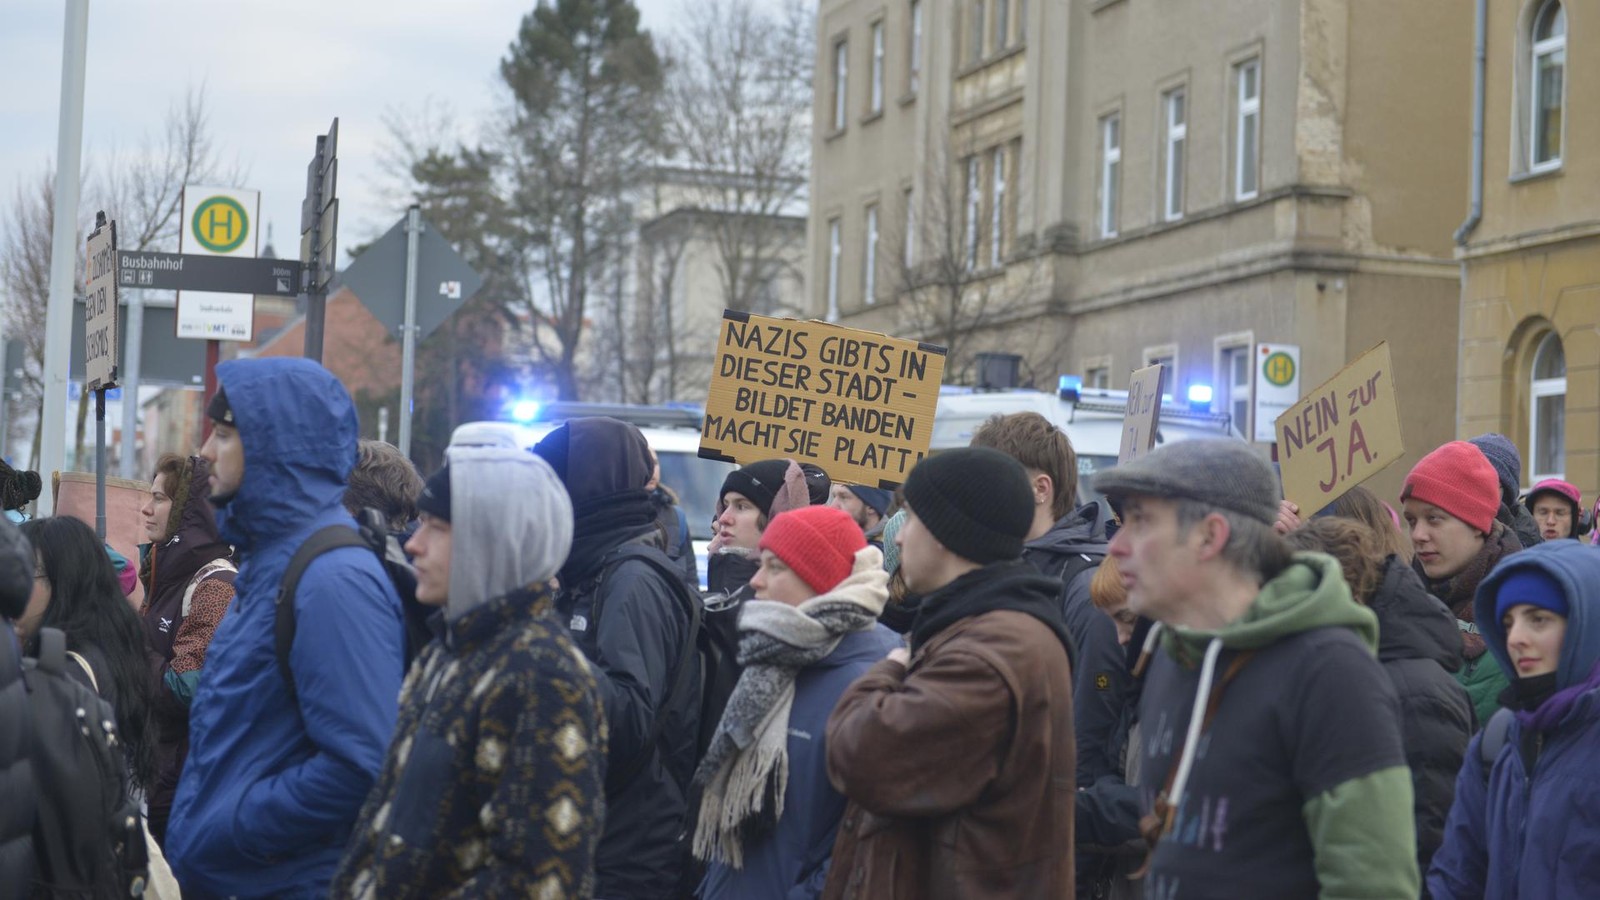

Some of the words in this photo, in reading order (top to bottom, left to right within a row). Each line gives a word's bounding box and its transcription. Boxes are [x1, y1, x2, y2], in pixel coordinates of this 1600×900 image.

[209, 208, 232, 240] H
[122, 255, 184, 271] Busbahnhof
[726, 322, 808, 360] NAZIS
[819, 336, 895, 374] GIBTS
[900, 350, 928, 381] IN
[720, 354, 812, 391] DIESER
[816, 368, 897, 404] STADT
[703, 414, 786, 449] MACHT
[784, 428, 822, 458] SIE
[735, 387, 817, 423] BILDET
[821, 402, 915, 441] BANDEN
[1283, 391, 1339, 458] NEIN
[1348, 370, 1382, 416] zur
[1316, 419, 1378, 493] J.A.
